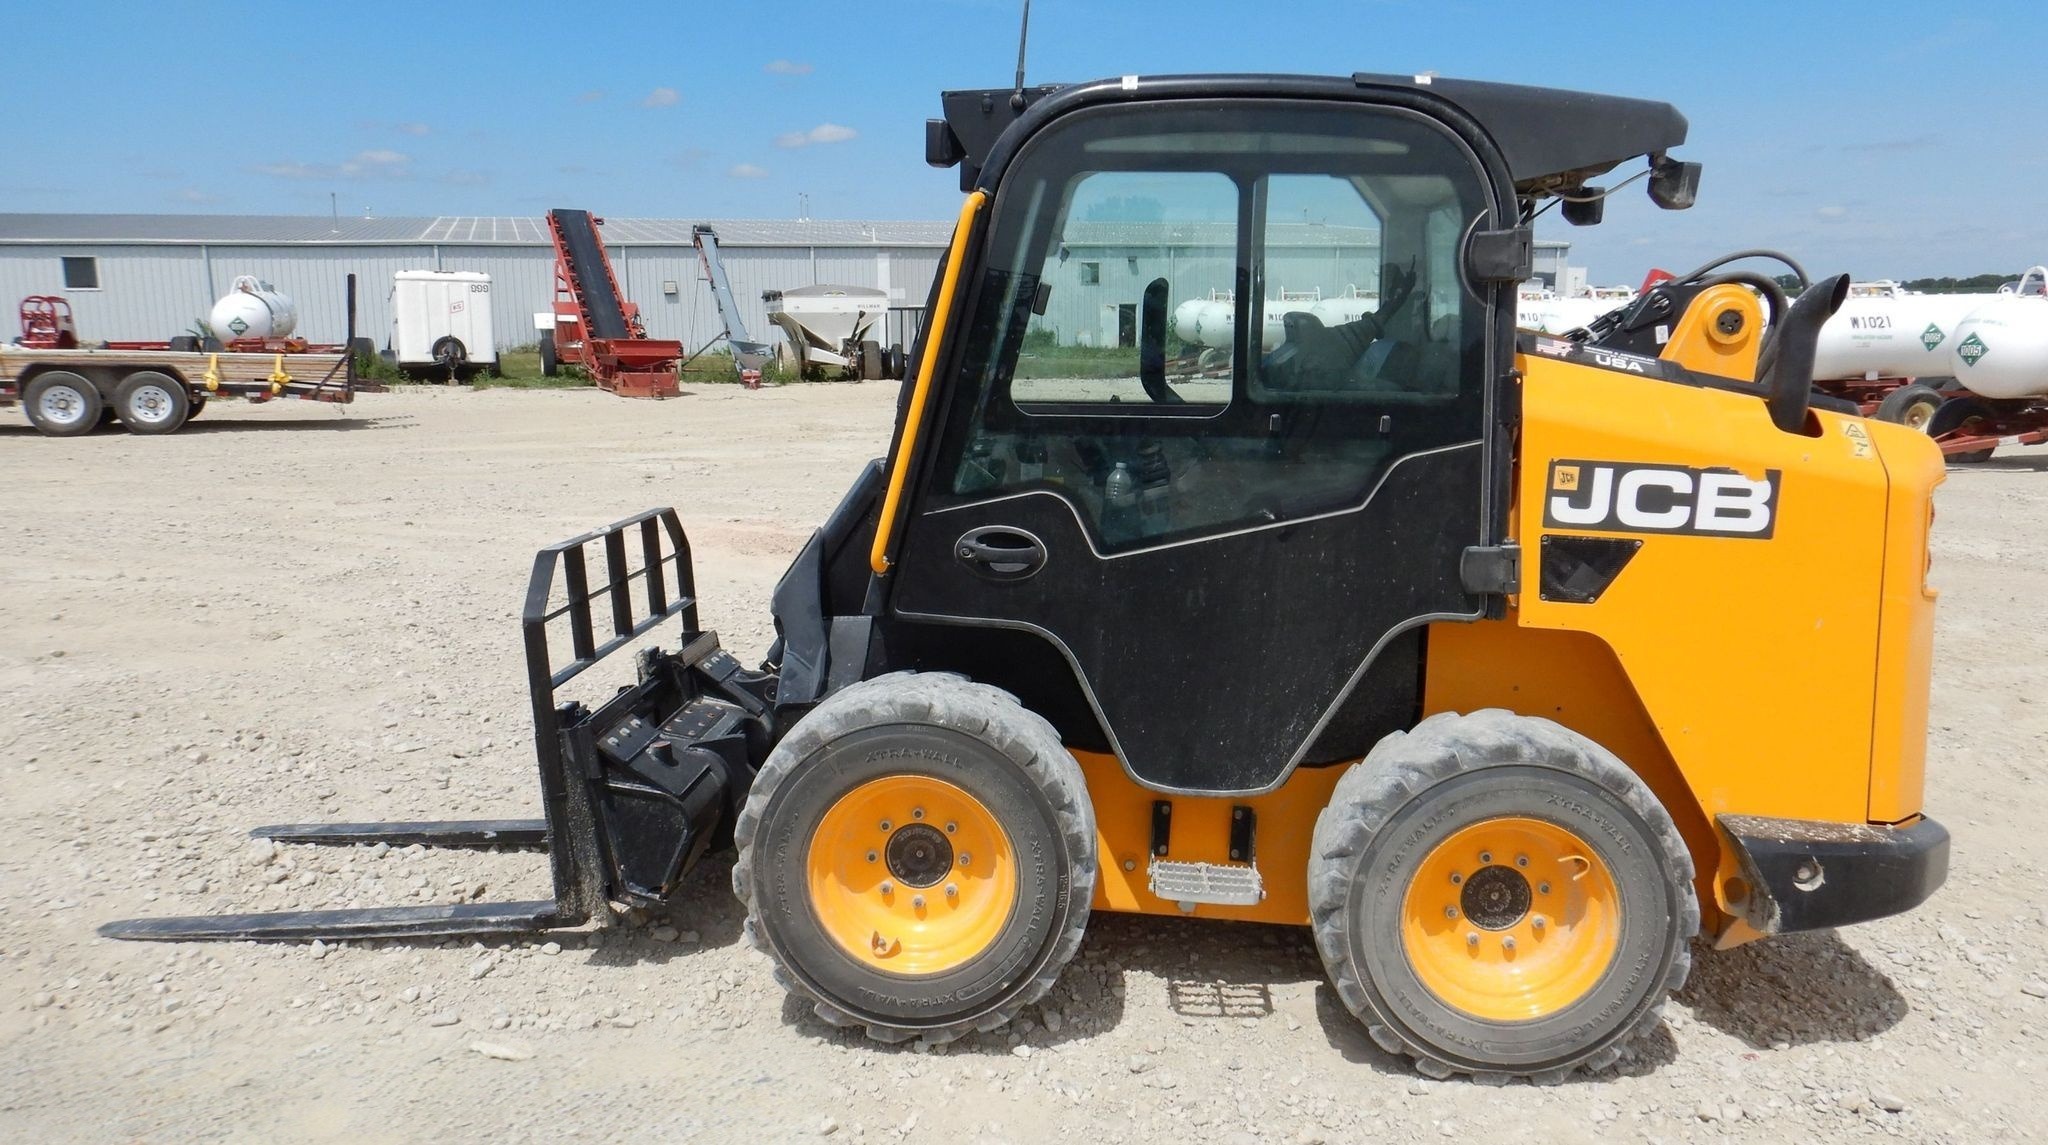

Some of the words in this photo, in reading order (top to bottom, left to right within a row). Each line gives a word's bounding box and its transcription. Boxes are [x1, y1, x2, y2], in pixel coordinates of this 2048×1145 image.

[1850, 315, 1891, 329] W1021
[1960, 345, 1981, 356] 1005
[1596, 354, 1644, 372] USA
[1551, 467, 1772, 533] JCB
